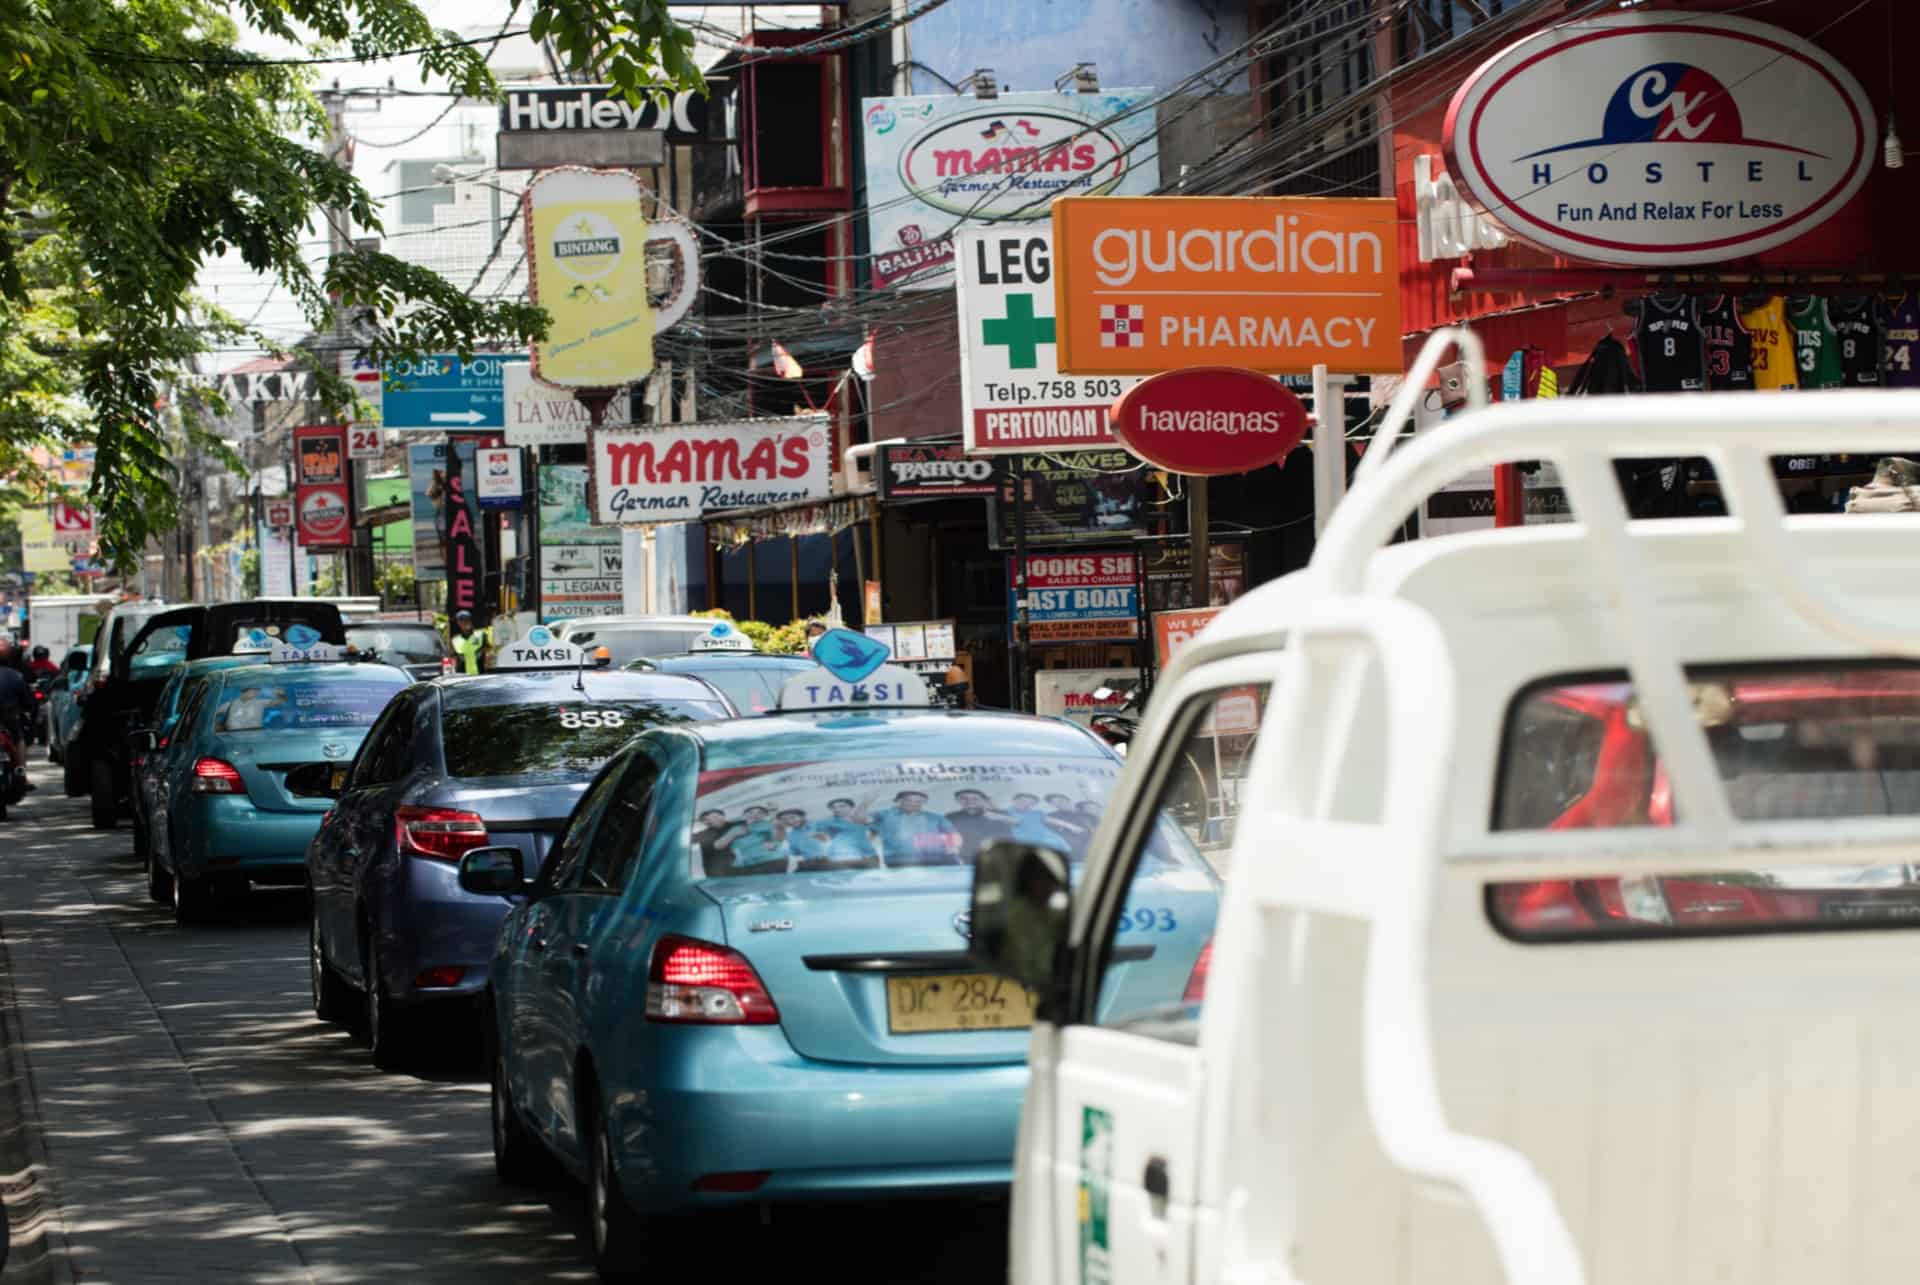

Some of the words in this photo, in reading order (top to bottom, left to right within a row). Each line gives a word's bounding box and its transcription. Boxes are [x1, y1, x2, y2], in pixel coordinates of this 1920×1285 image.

[509, 91, 647, 131] Hurley
[938, 177, 1001, 199] German
[1557, 203, 1593, 222] Fun
[1600, 202, 1637, 222] And
[1643, 201, 1697, 221] Relax
[1701, 201, 1734, 219] For
[1739, 200, 1784, 219] Less
[1093, 215, 1383, 287] guardian
[1160, 316, 1377, 348] PHARMACY
[1664, 338, 1675, 357] 8
[1844, 339, 1855, 358] 8
[985, 382, 1076, 403] Telp.758
[1085, 379, 1123, 398] 503
[516, 401, 542, 424] LA
[1140, 405, 1280, 435] havaianas
[986, 409, 1099, 440] PERTOKOAN
[352, 431, 379, 449] 24
[607, 434, 811, 486] MAMA'S
[610, 488, 690, 519] German
[699, 485, 809, 508] Restaurant
[449, 476, 475, 608] SALE
[564, 581, 611, 593] LEGIAN
[1028, 590, 1070, 611] AST
[1074, 587, 1131, 609] BOAT
[282, 650, 328, 660] TAKSI
[513, 648, 571, 662] TAKSI
[806, 683, 904, 703] TAKSI
[560, 710, 625, 729] 858
[952, 978, 1006, 1012] 284
